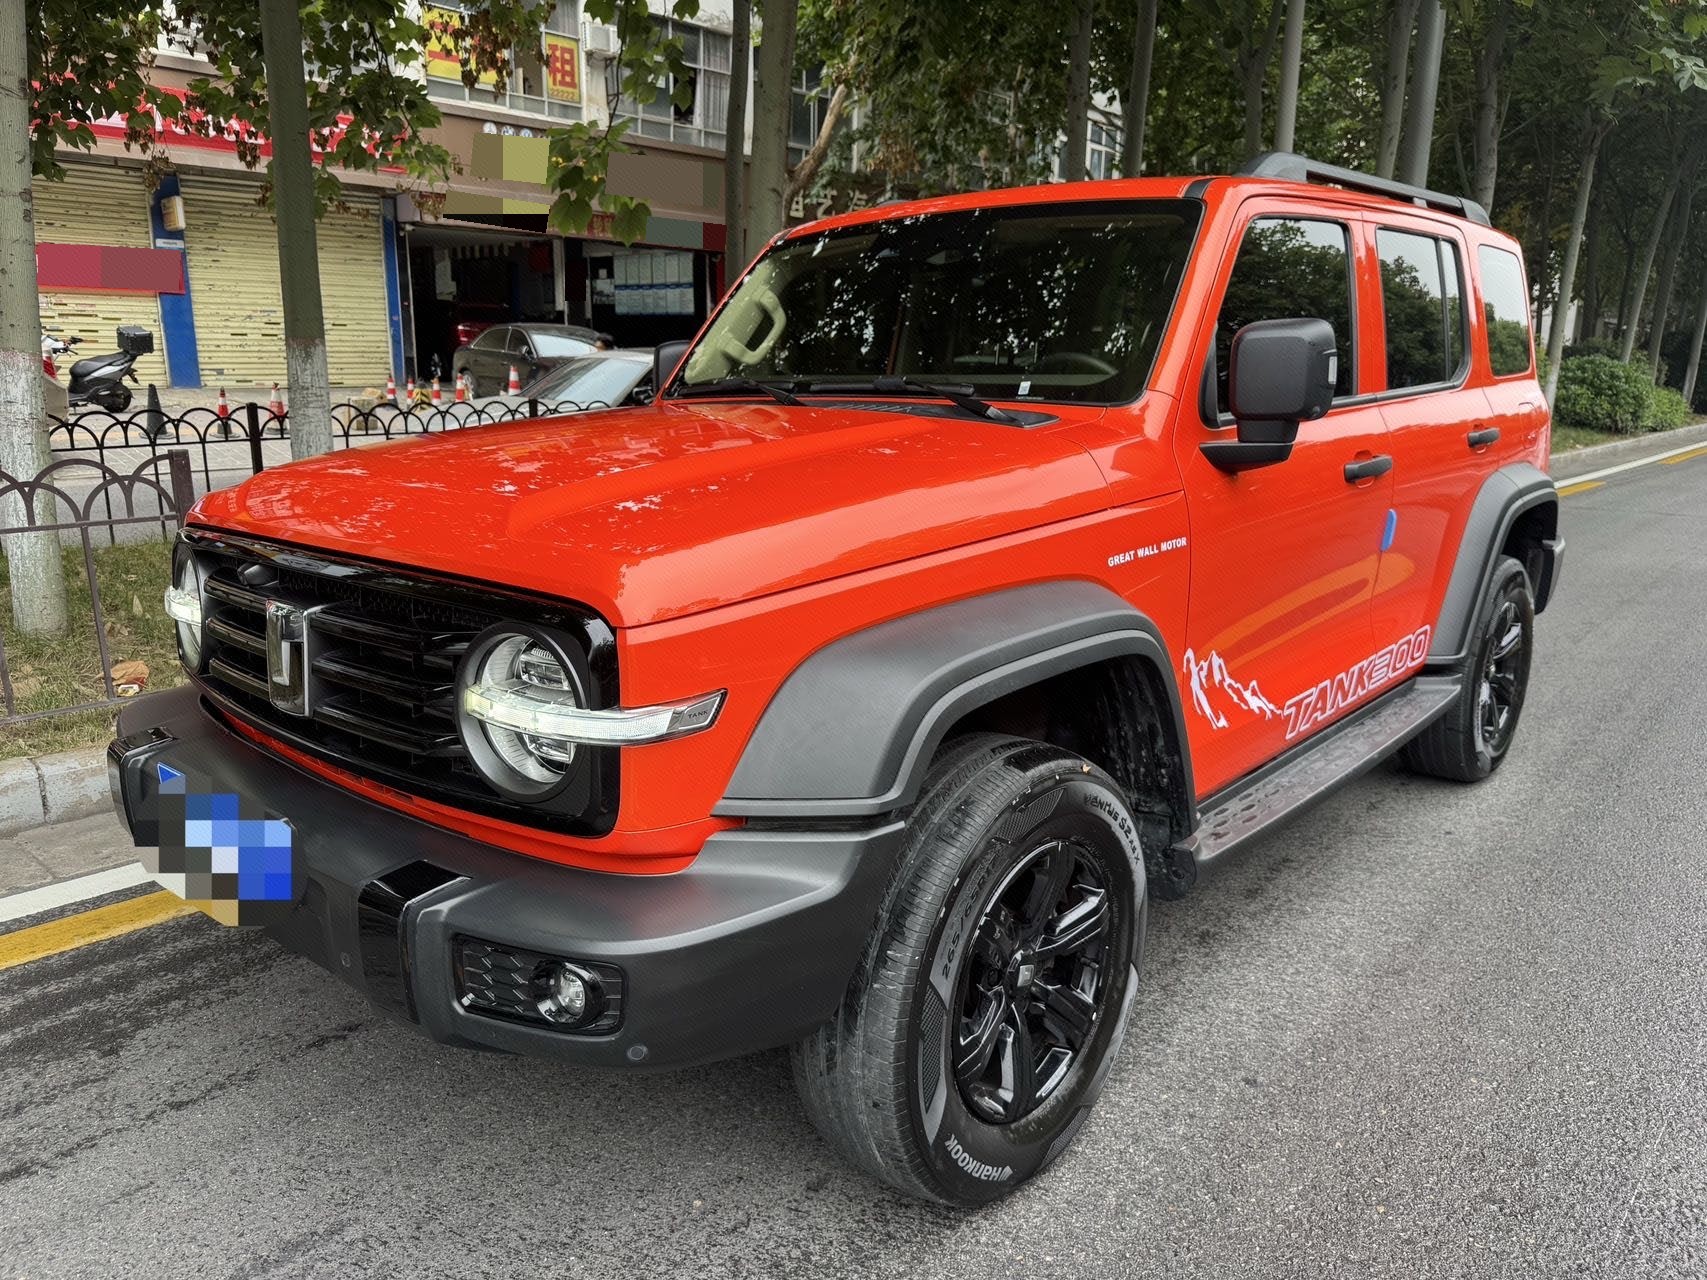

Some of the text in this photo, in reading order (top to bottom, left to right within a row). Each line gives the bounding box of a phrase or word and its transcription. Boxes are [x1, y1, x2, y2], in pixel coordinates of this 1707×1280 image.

[548, 44, 577, 89] 租
[1107, 536, 1188, 567] GREAT WALL MOTOR
[1283, 624, 1431, 740] TANK300
[688, 710, 708, 719] TANK
[1118, 816, 1132, 839] S2
